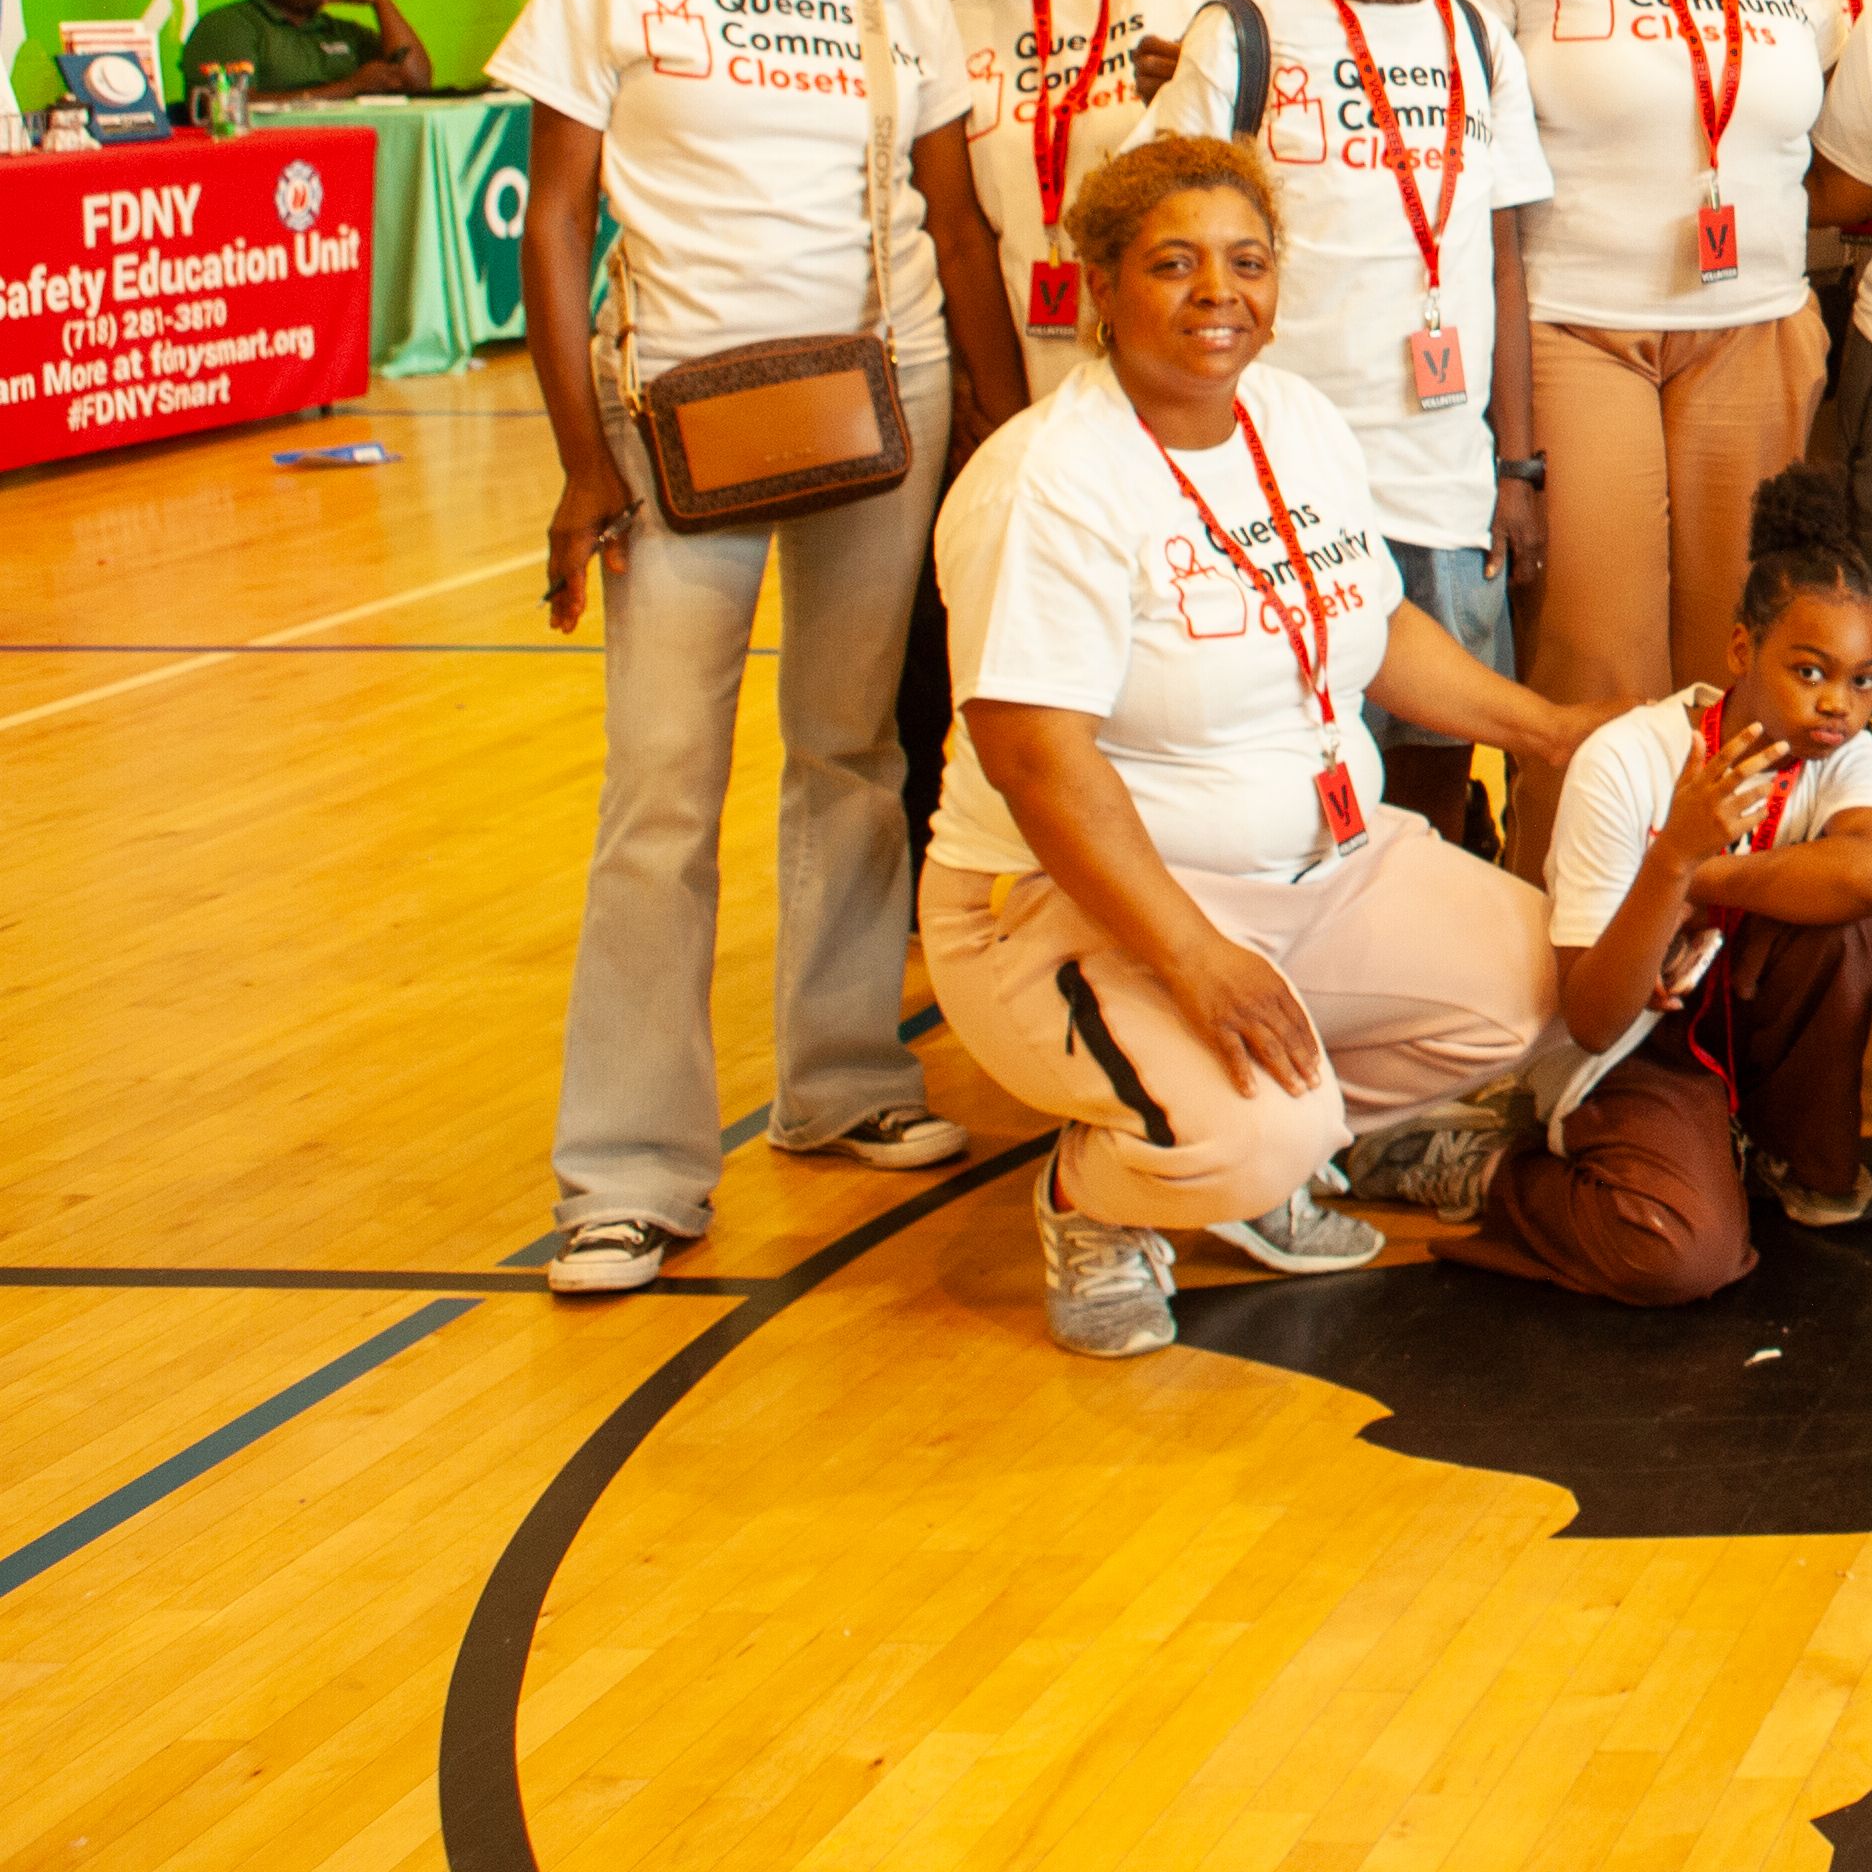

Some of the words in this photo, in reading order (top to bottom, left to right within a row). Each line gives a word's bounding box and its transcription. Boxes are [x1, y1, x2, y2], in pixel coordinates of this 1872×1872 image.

[728, 55, 868, 99] Closets
[1369, 78, 1401, 157] VOLUNTEER
[82, 183, 202, 249] FDNY
[112, 237, 289, 302] Education
[294, 224, 361, 278] Unit
[62, 311, 119, 356] (718)
[121, 297, 228, 341] 281-3870
[0, 372, 36, 406] arn
[42, 359, 108, 397] More
[113, 347, 144, 382] at
[149, 325, 316, 379] fdnysmart.org
